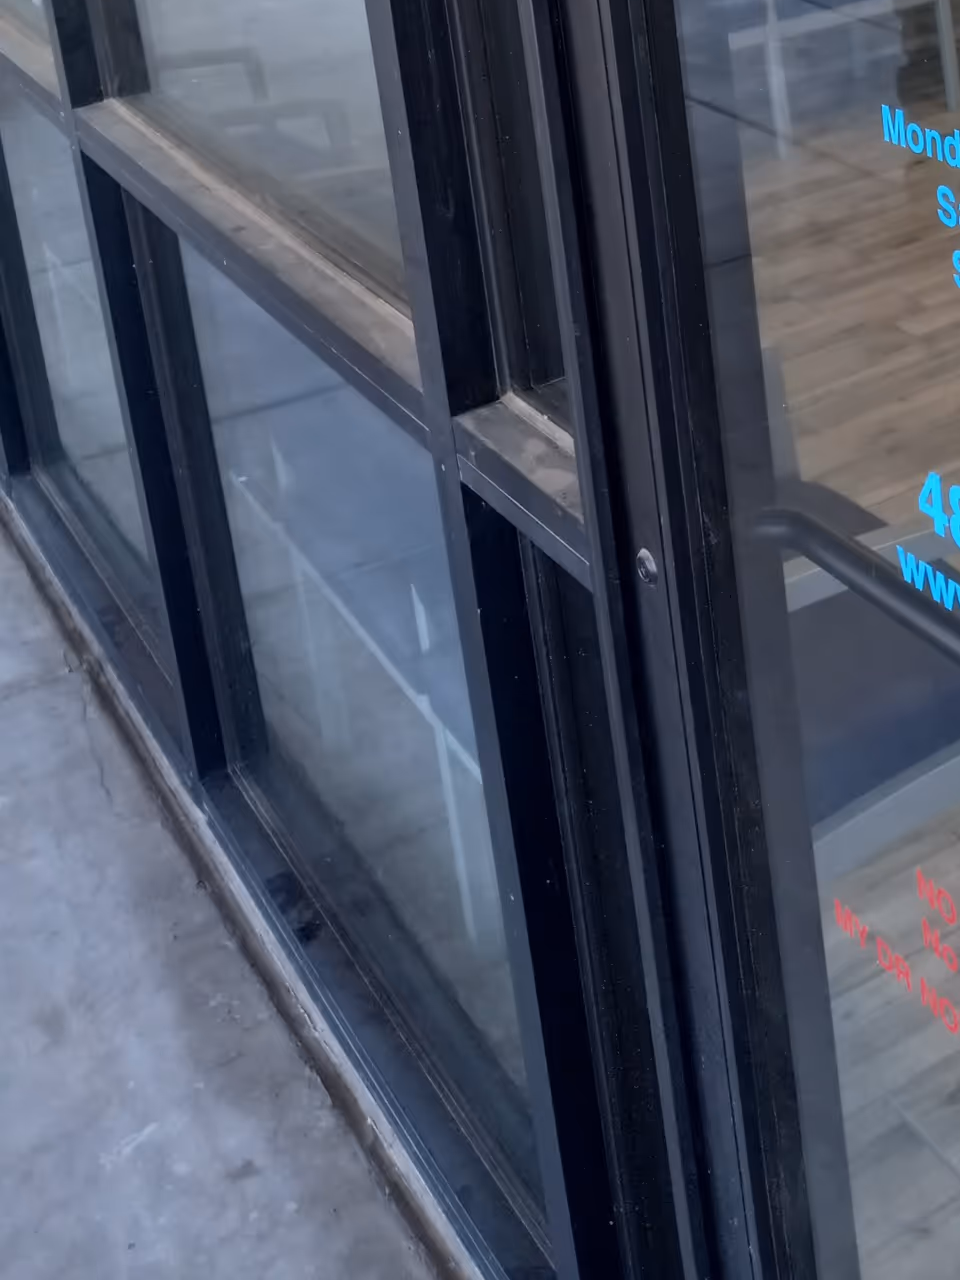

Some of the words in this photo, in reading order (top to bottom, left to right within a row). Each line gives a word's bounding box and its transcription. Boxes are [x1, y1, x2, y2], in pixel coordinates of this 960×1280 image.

[917, 867, 957, 925] NO
[834, 898, 868, 948] MY
[876, 937, 912, 992] DR
[922, 917, 958, 972] No
